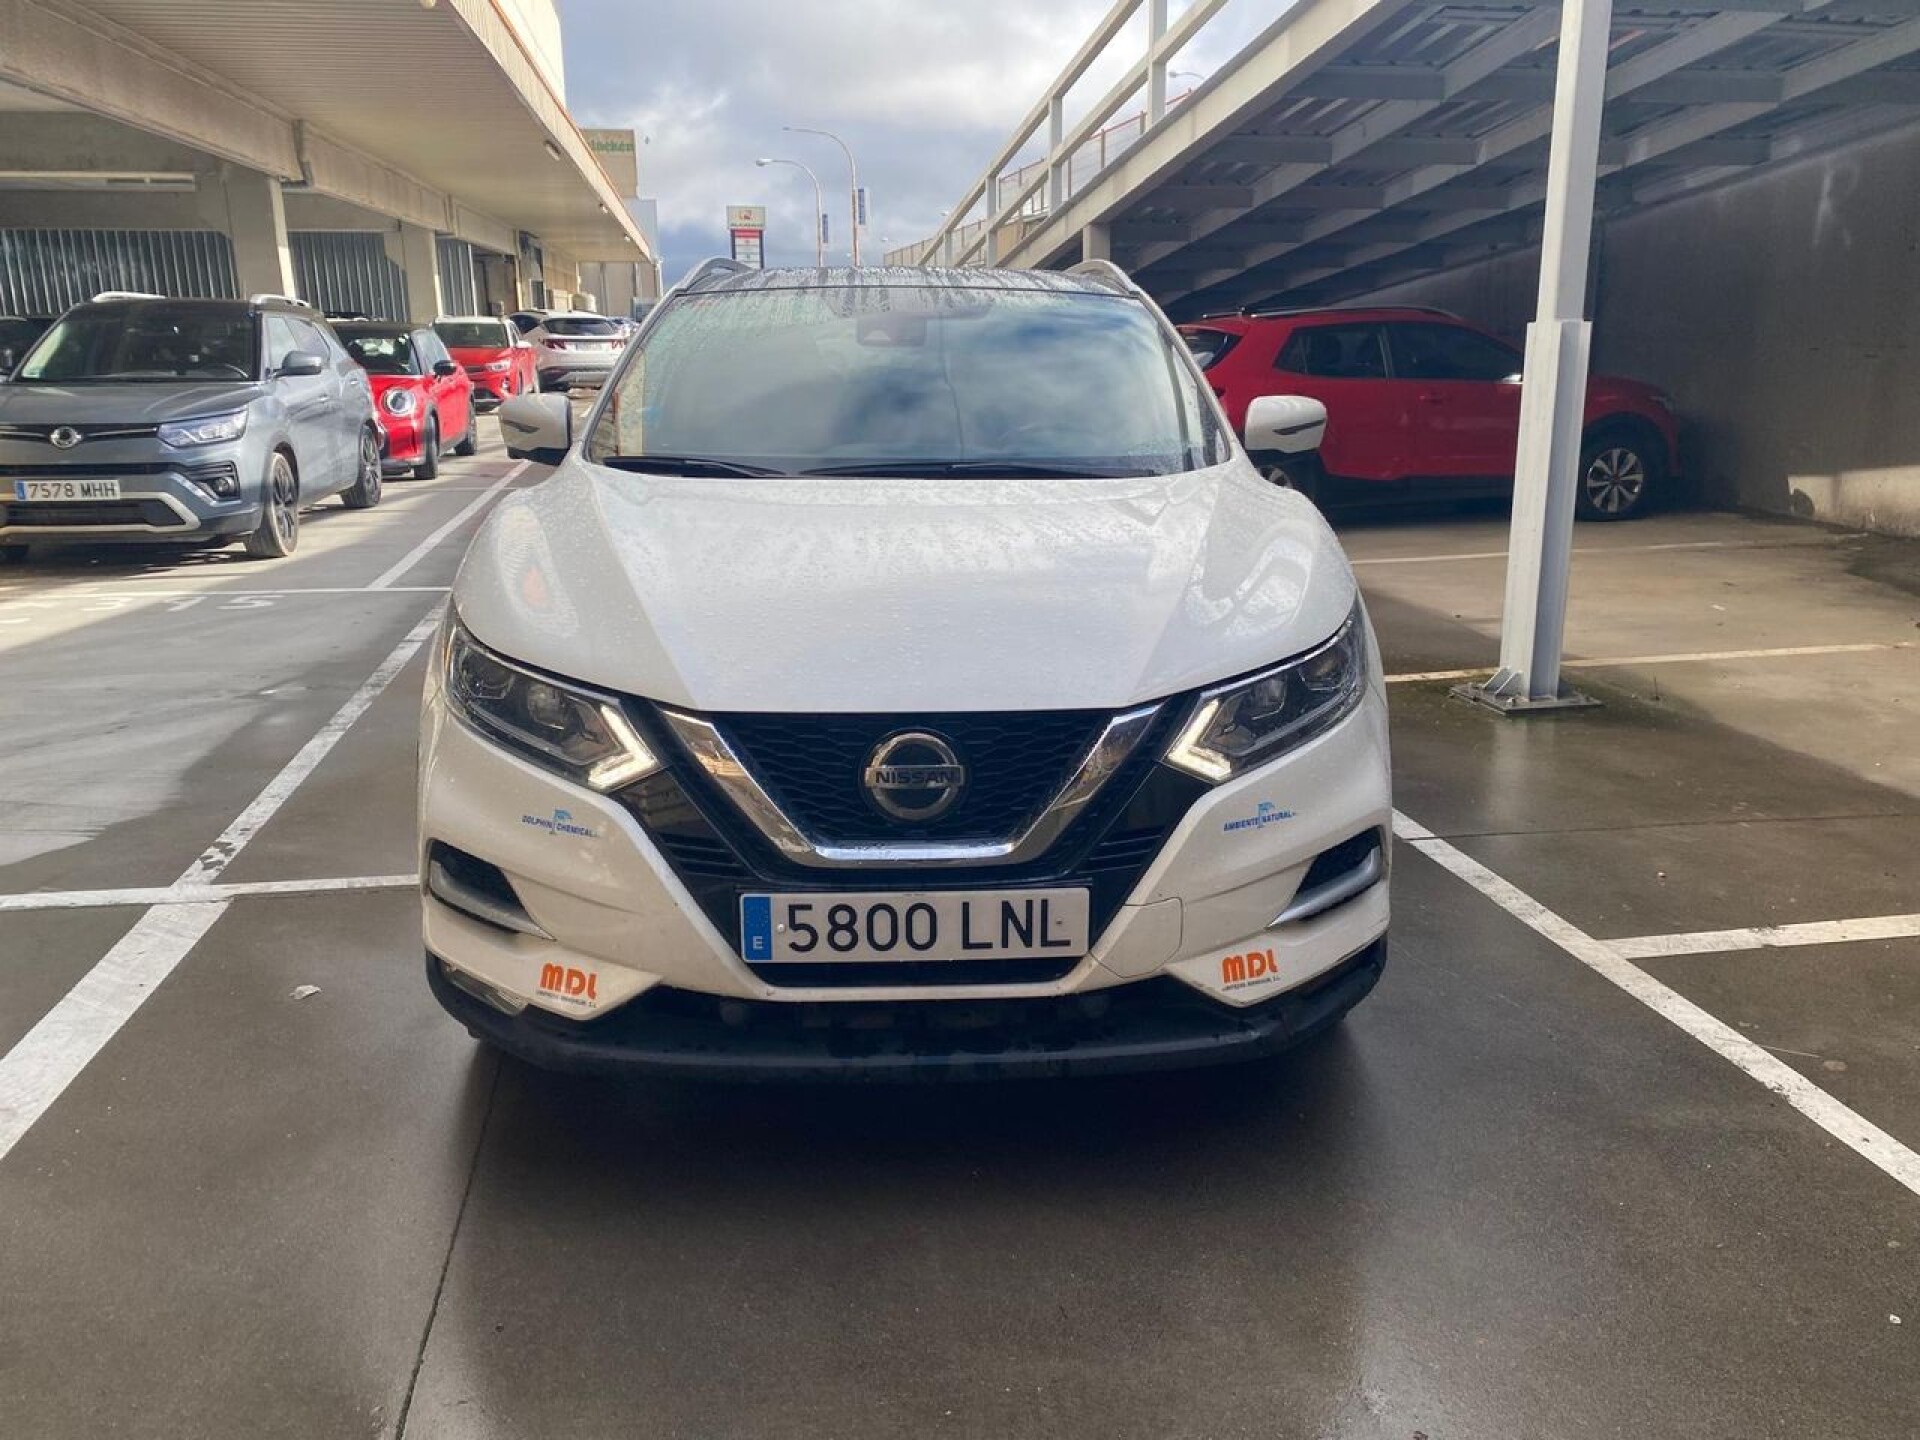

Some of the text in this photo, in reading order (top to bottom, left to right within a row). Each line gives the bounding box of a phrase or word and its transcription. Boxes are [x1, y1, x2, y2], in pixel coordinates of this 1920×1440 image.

[28, 482, 116, 499] 7578 MHH
[875, 767, 958, 784] NISSAN
[522, 815, 593, 837] DOLPHIN CHEMICAL
[1224, 811, 1292, 831] AMBIENTE NATURAL
[752, 899, 1072, 952] E 5800 LNL
[1222, 948, 1278, 984] MDL
[540, 963, 597, 1000] MDL
